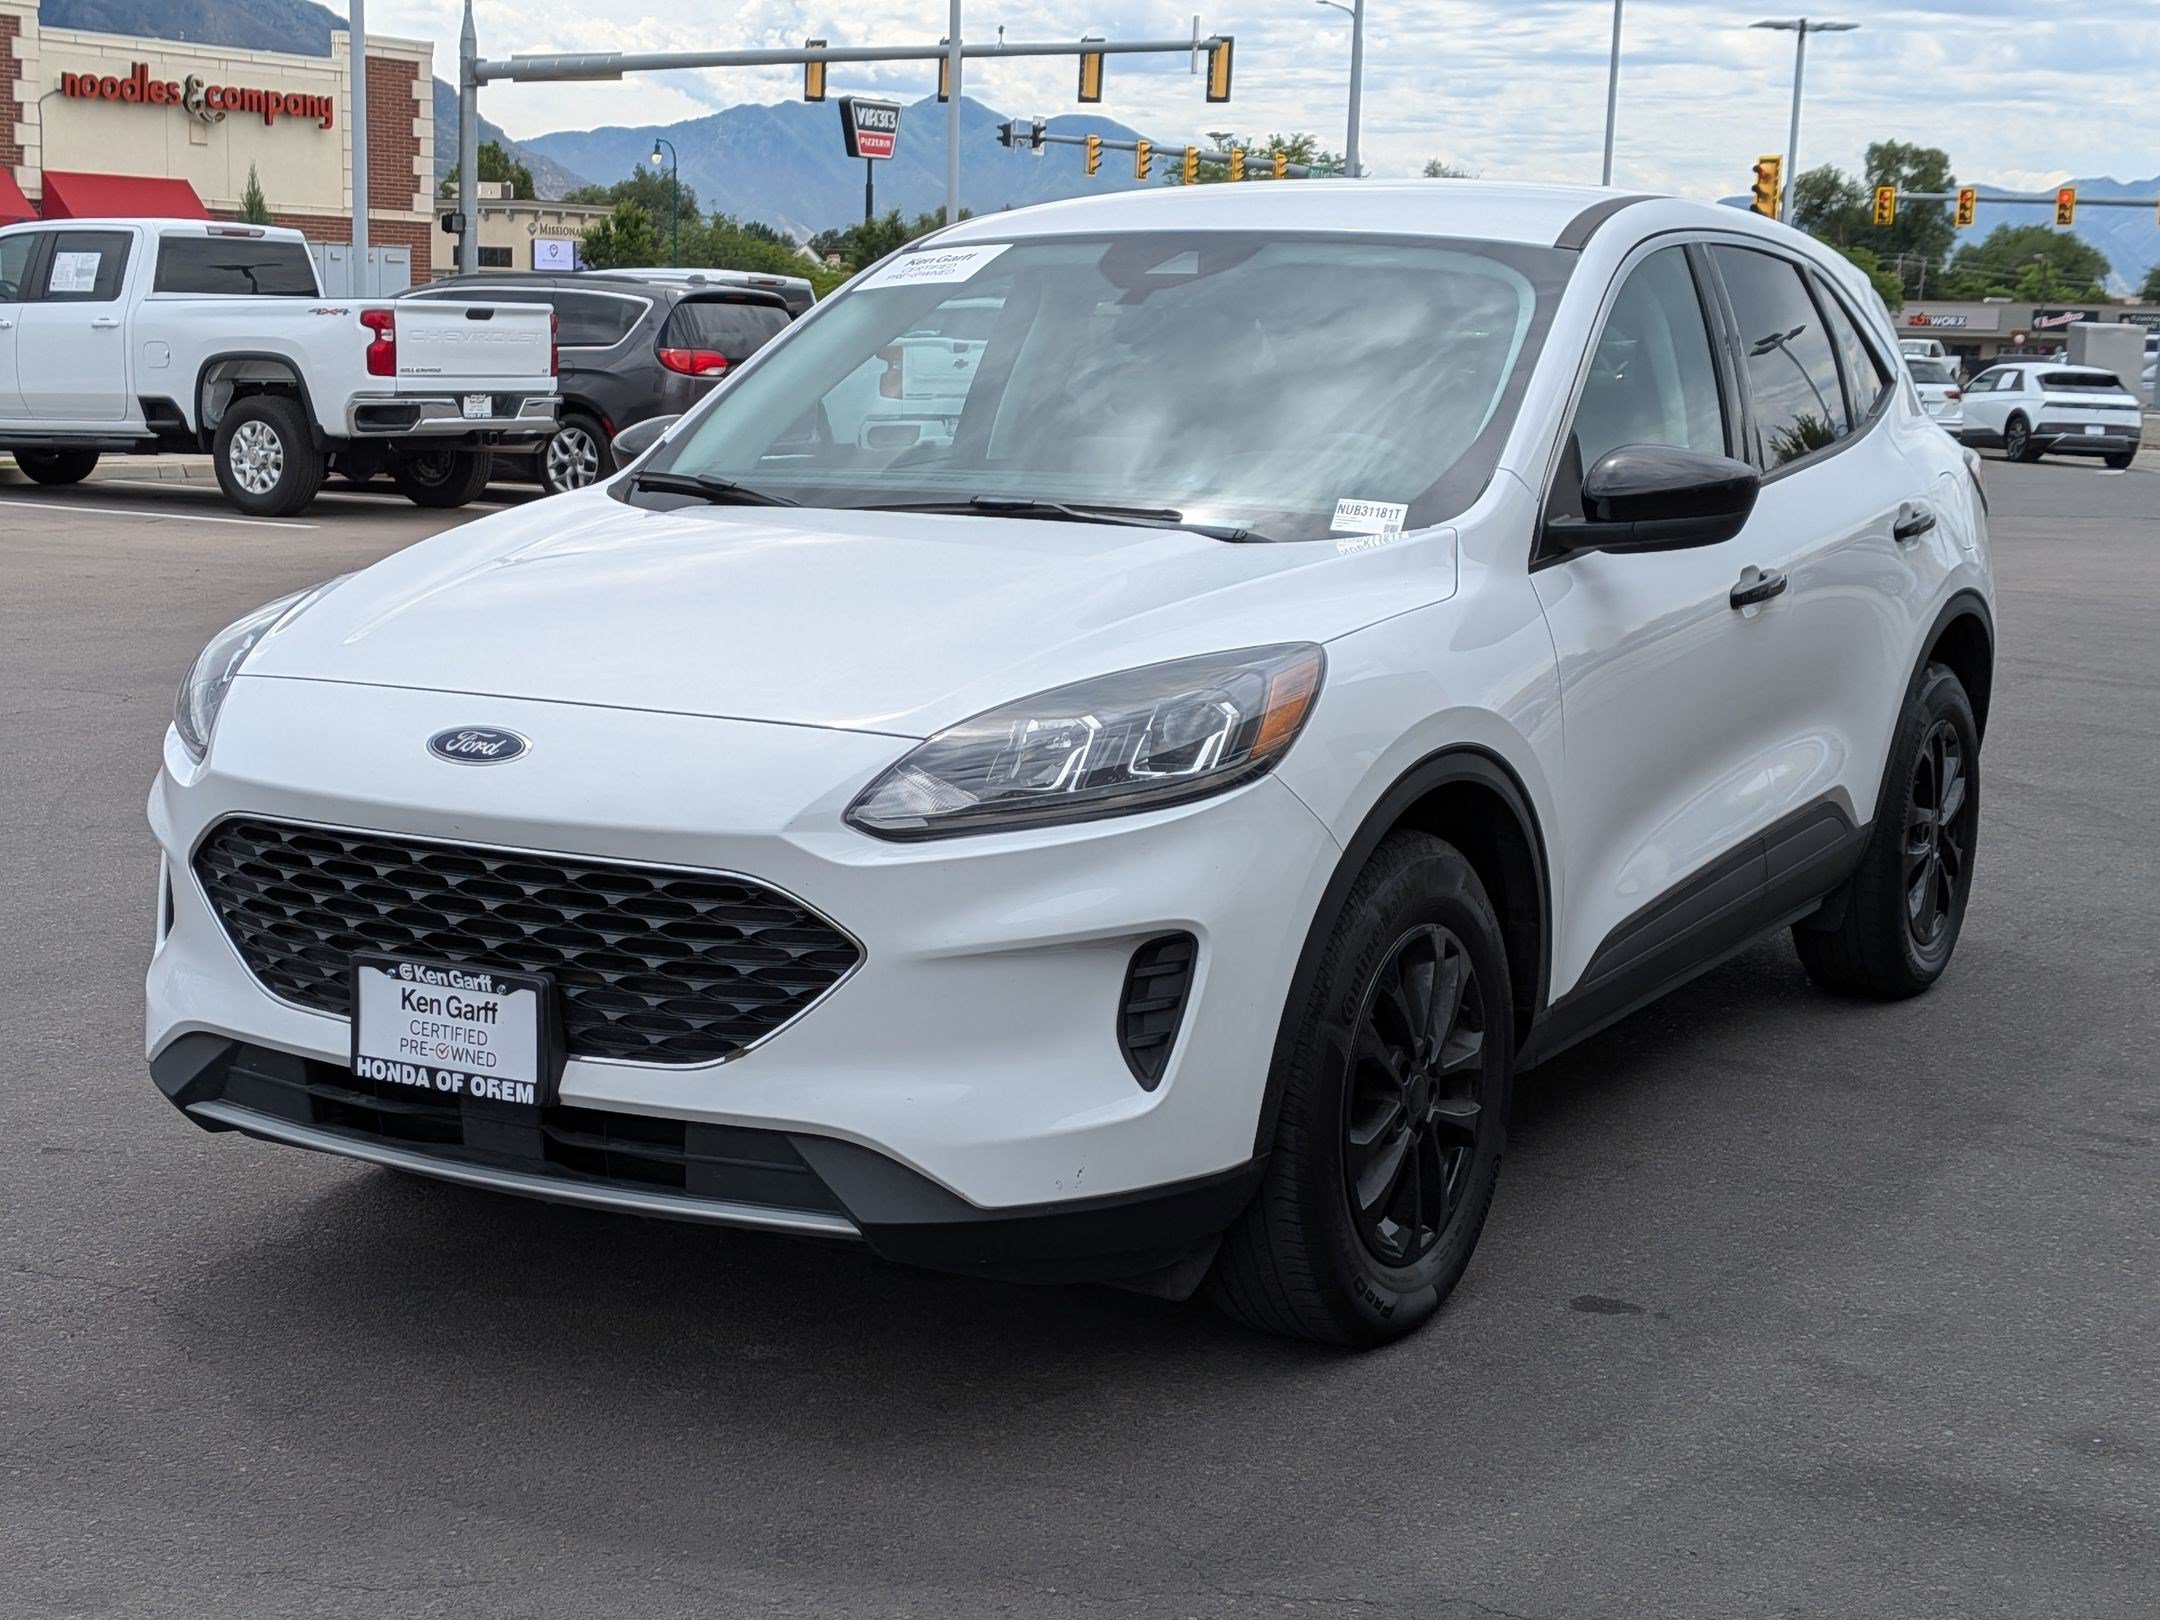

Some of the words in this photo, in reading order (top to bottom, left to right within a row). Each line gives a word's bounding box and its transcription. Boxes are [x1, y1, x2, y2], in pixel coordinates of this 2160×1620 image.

[61, 61, 181, 105] noodles
[183, 73, 226, 124] &
[204, 85, 334, 130] company
[539, 222, 583, 238] MISSIONA
[904, 257, 936, 267] Ken
[936, 252, 980, 263] Garff
[409, 329, 543, 344] CHEVROLET
[1336, 503, 1403, 520] NUB31181T
[445, 730, 507, 756] Ford
[413, 964, 447, 987] Ken
[449, 970, 493, 993] Garff
[401, 987, 442, 1016] Ken
[445, 995, 499, 1025] Garff
[410, 1019, 488, 1046] CERTIFIED
[356, 1056, 431, 1089] HONDA
[435, 1070, 465, 1093] OF
[470, 1076, 535, 1104] OREM
